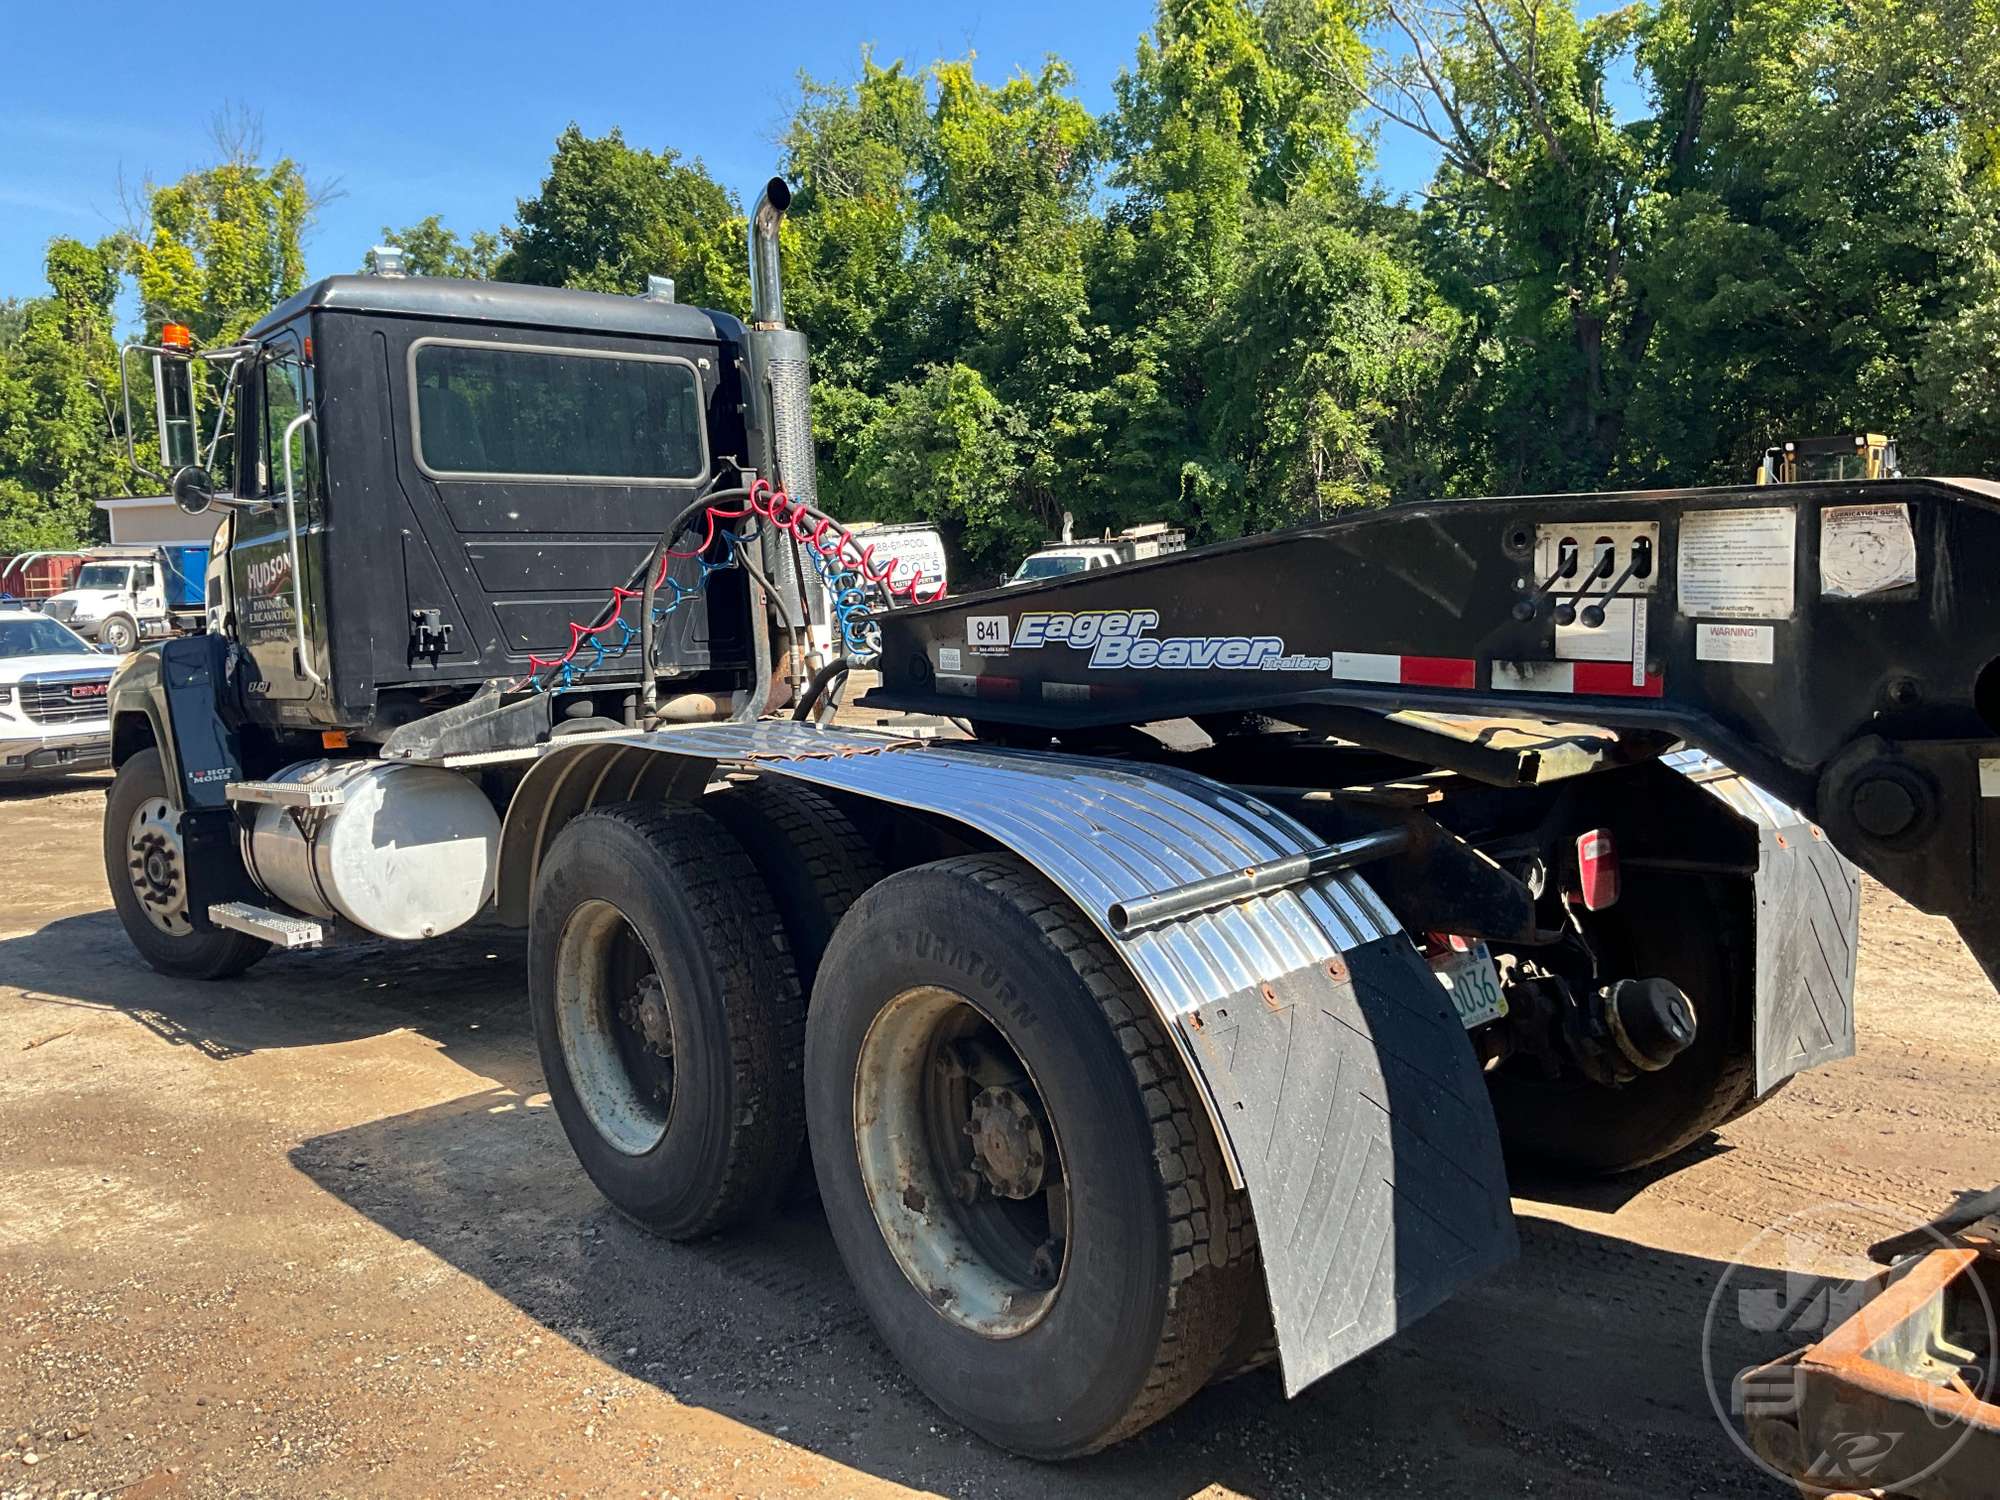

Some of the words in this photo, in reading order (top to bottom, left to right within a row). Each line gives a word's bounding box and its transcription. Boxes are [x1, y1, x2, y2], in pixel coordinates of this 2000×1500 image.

[247, 551, 292, 593] HUDSON
[899, 560, 940, 576] OOLS
[976, 620, 999, 640] 841
[1011, 610, 1159, 649] Eager
[1710, 627, 1757, 638] WARNING!
[1088, 636, 1284, 669] Beaver
[72, 683, 107, 697] GM
[193, 774, 230, 784] MOMS
[207, 767, 233, 776] HOT
